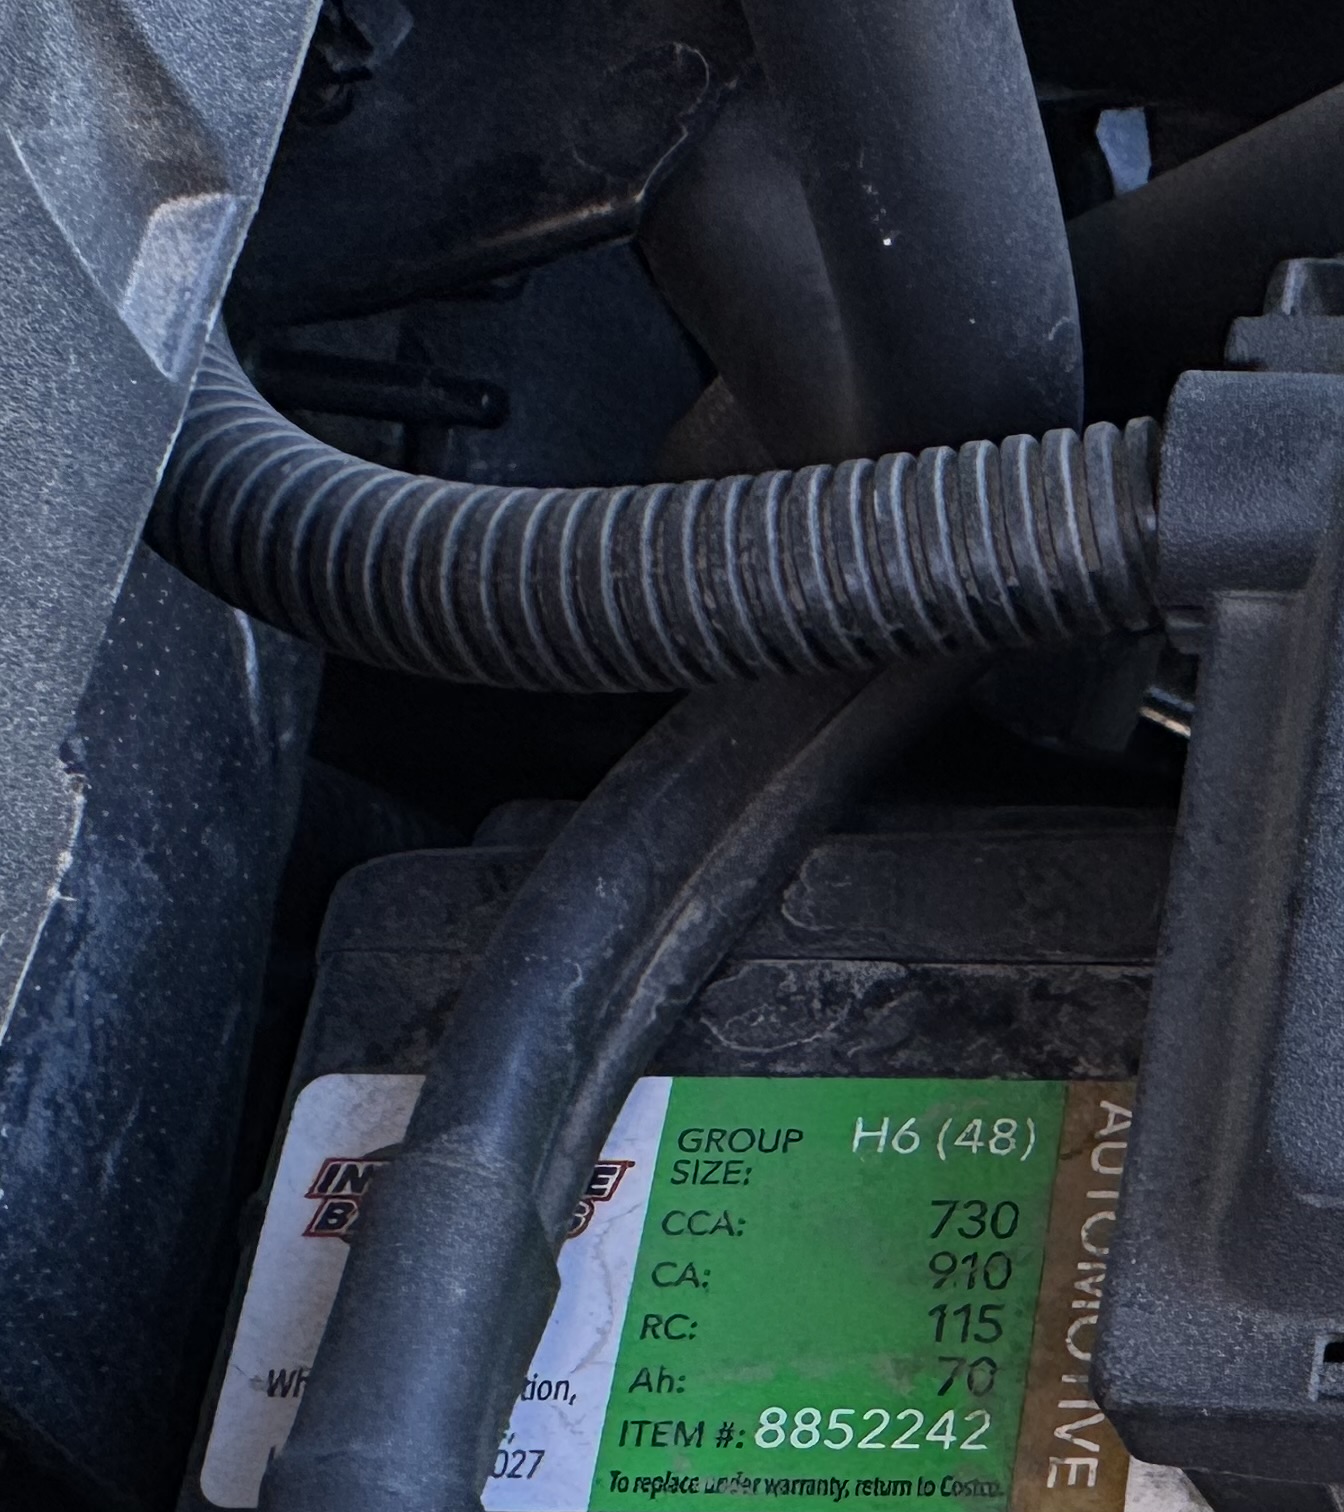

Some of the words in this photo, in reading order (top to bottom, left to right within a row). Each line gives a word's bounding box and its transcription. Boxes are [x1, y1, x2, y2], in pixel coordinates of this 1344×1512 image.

[677, 1127, 804, 1154] GROUP
[851, 1116, 921, 1154] H6
[935, 1116, 1036, 1162] (48)
[669, 1159, 753, 1186] SIZE:
[660, 1209, 747, 1237] CCA:
[929, 1200, 1020, 1240] 730
[650, 1261, 711, 1290] CA:
[928, 1250, 1012, 1291] 910
[639, 1313, 698, 1341] RC:
[927, 1303, 1005, 1344] 115
[628, 1365, 686, 1394] Ah:
[937, 1356, 999, 1397] 70
[618, 1419, 705, 1448] ITEM
[714, 1421, 745, 1450] #:
[753, 1406, 993, 1451] 8852242
[609, 1469, 630, 1495] To
[634, 1470, 700, 1500] replace
[703, 1471, 761, 1496] under
[764, 1474, 850, 1503] warranty,
[854, 1474, 914, 1497] return
[916, 1475, 936, 1497] to
